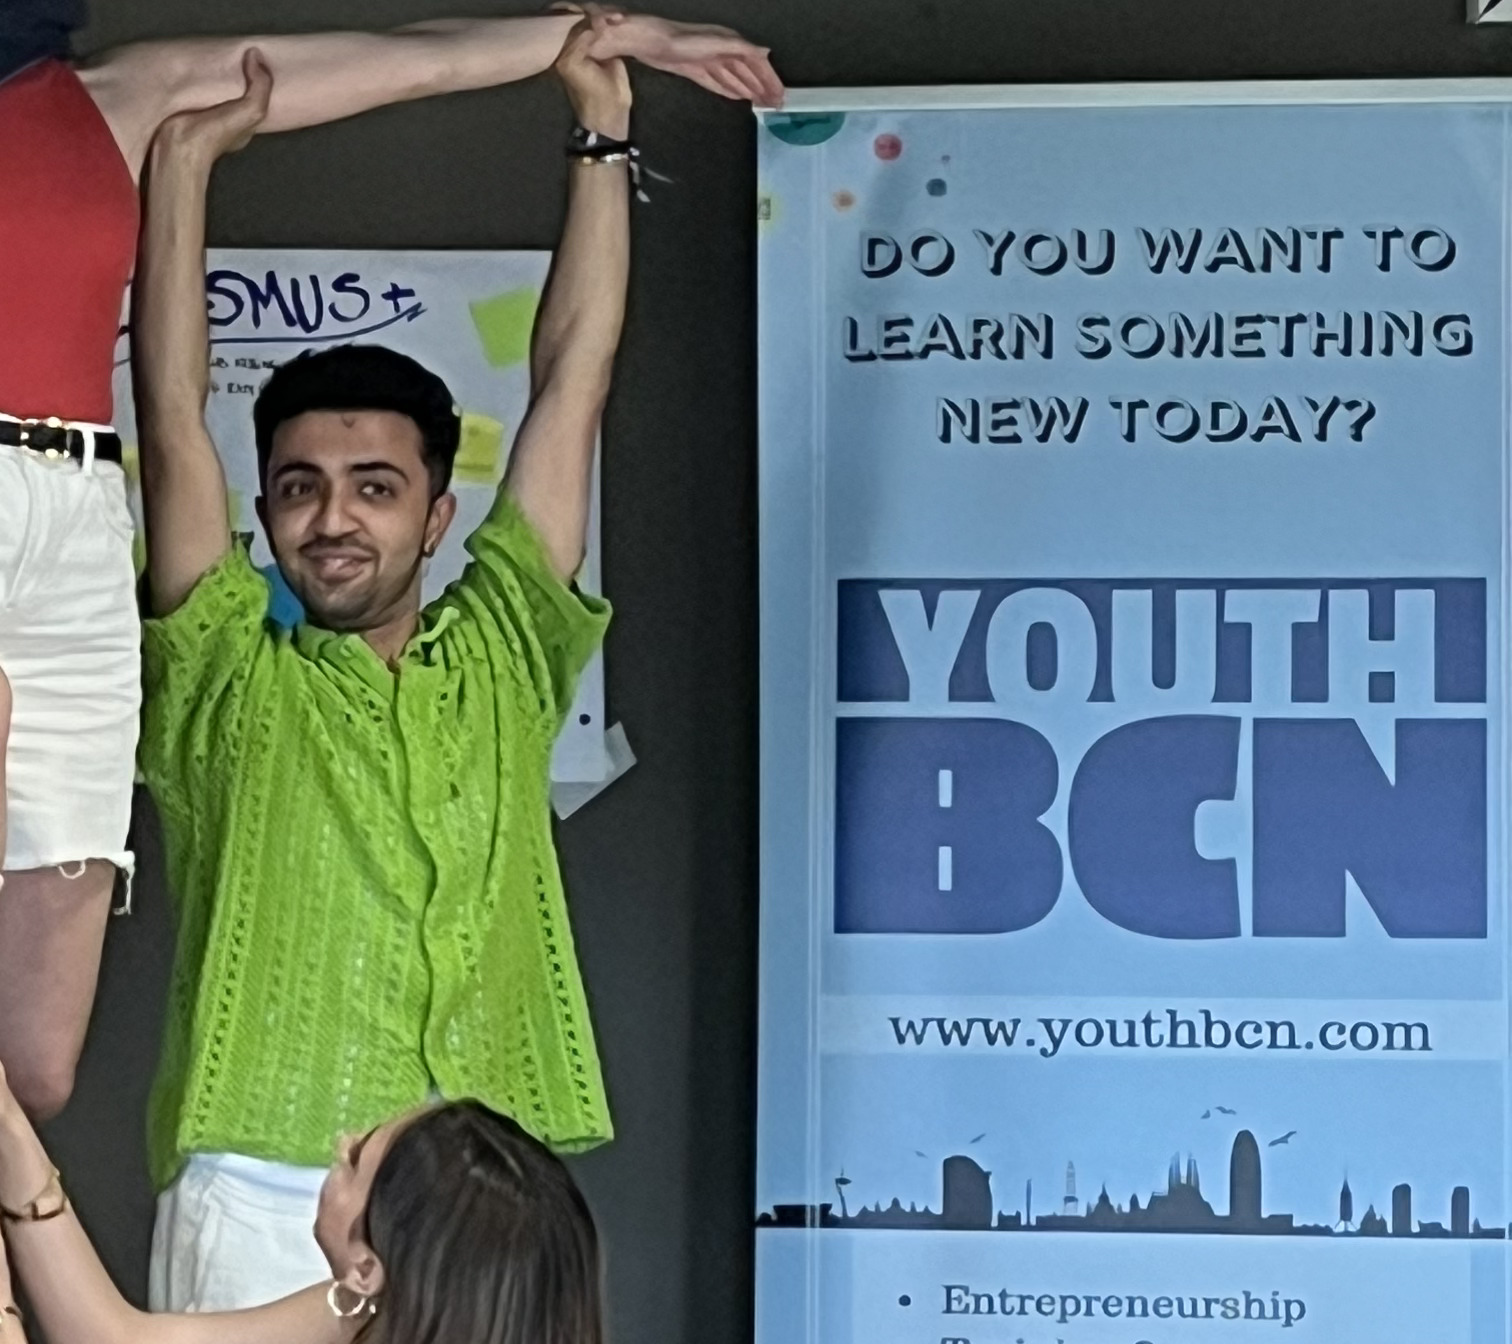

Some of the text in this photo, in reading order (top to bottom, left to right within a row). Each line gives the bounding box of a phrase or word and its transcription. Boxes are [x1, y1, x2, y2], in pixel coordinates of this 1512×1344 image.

[860, 223, 1456, 278] DO YOU WANT TO
[843, 309, 1474, 362] LEARN SOMETHING
[937, 394, 1376, 444] NEW TODAY?
[877, 587, 1436, 703] YOUTH
[834, 714, 1488, 940] BCN
[888, 1009, 1434, 1059] www.youthbcn.com
[941, 1284, 1307, 1328] Entrepreneurship
